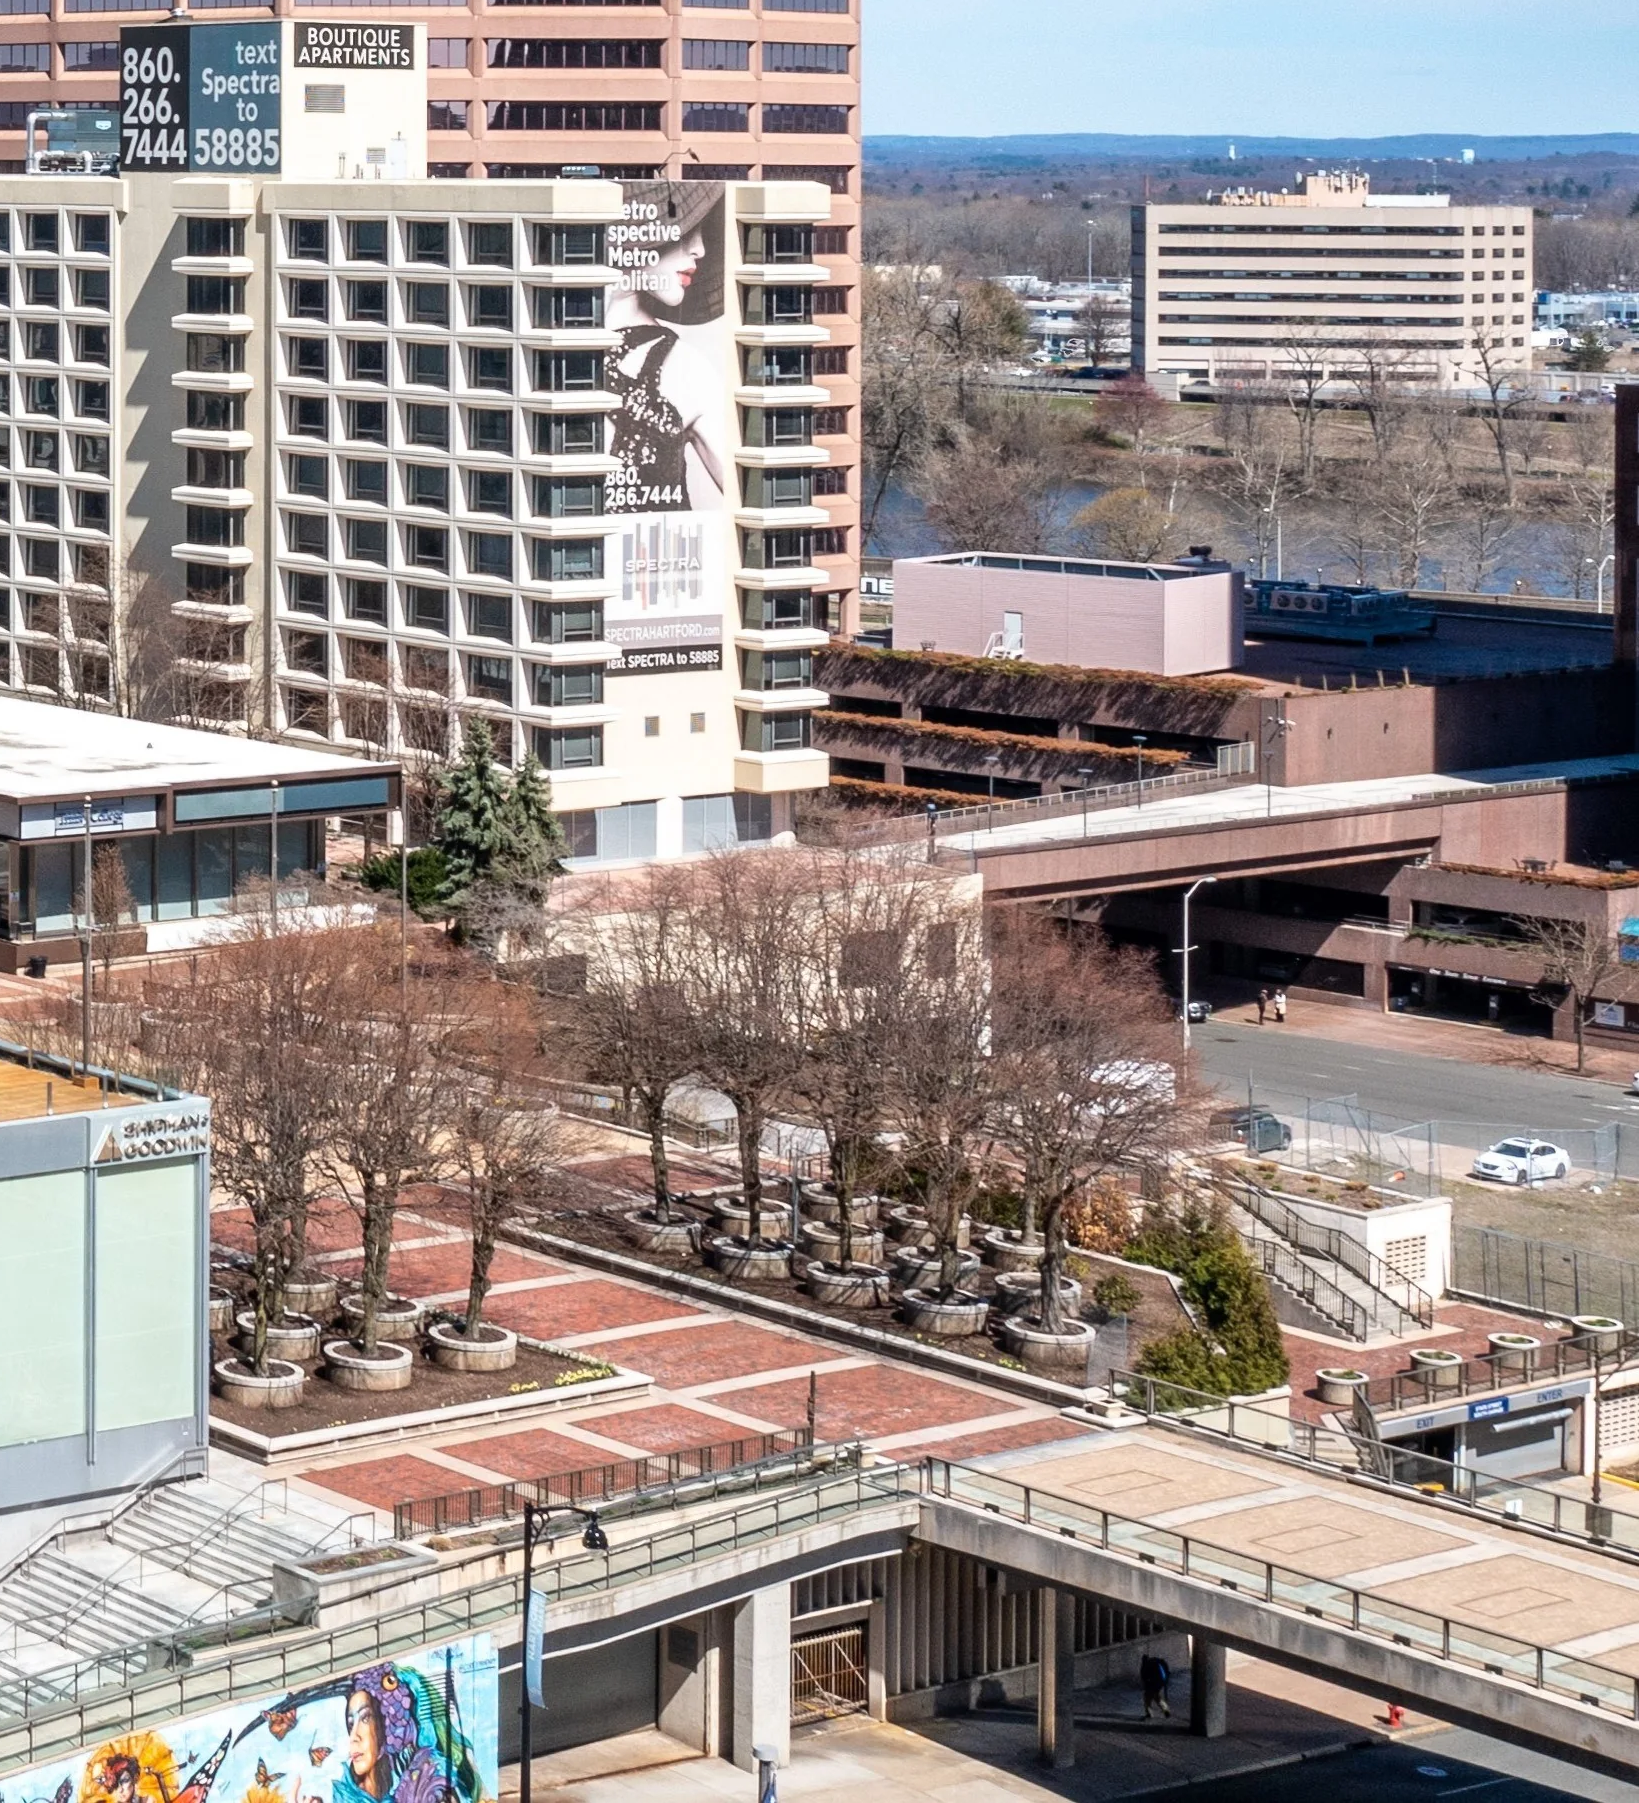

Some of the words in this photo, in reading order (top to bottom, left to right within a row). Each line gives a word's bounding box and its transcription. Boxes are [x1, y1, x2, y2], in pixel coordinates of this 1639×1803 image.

[307, 27, 401, 47] BOUTIQUE
[235, 40, 277, 65] text
[298, 46, 410, 66] APARTMENTS
[123, 46, 181, 84] 860.
[201, 67, 281, 103] Spectra
[123, 87, 180, 125] 266.
[236, 98, 259, 122] to
[123, 128, 187, 165] 7444
[194, 128, 280, 166] 58885
[622, 200, 659, 220] etro
[608, 220, 681, 246] spective
[608, 246, 660, 267] Metro
[605, 484, 683, 507] 266.7444
[625, 557, 701, 573] SPECTRA
[604, 624, 721, 642] SPECTRAHARTFORD.com
[627, 652, 675, 669] SPECTRA
[676, 651, 688, 665] to
[689, 650, 720, 665] 58885
[1536, 1389, 1563, 1404] ENTER
[1416, 1416, 1435, 1429] EXIT
